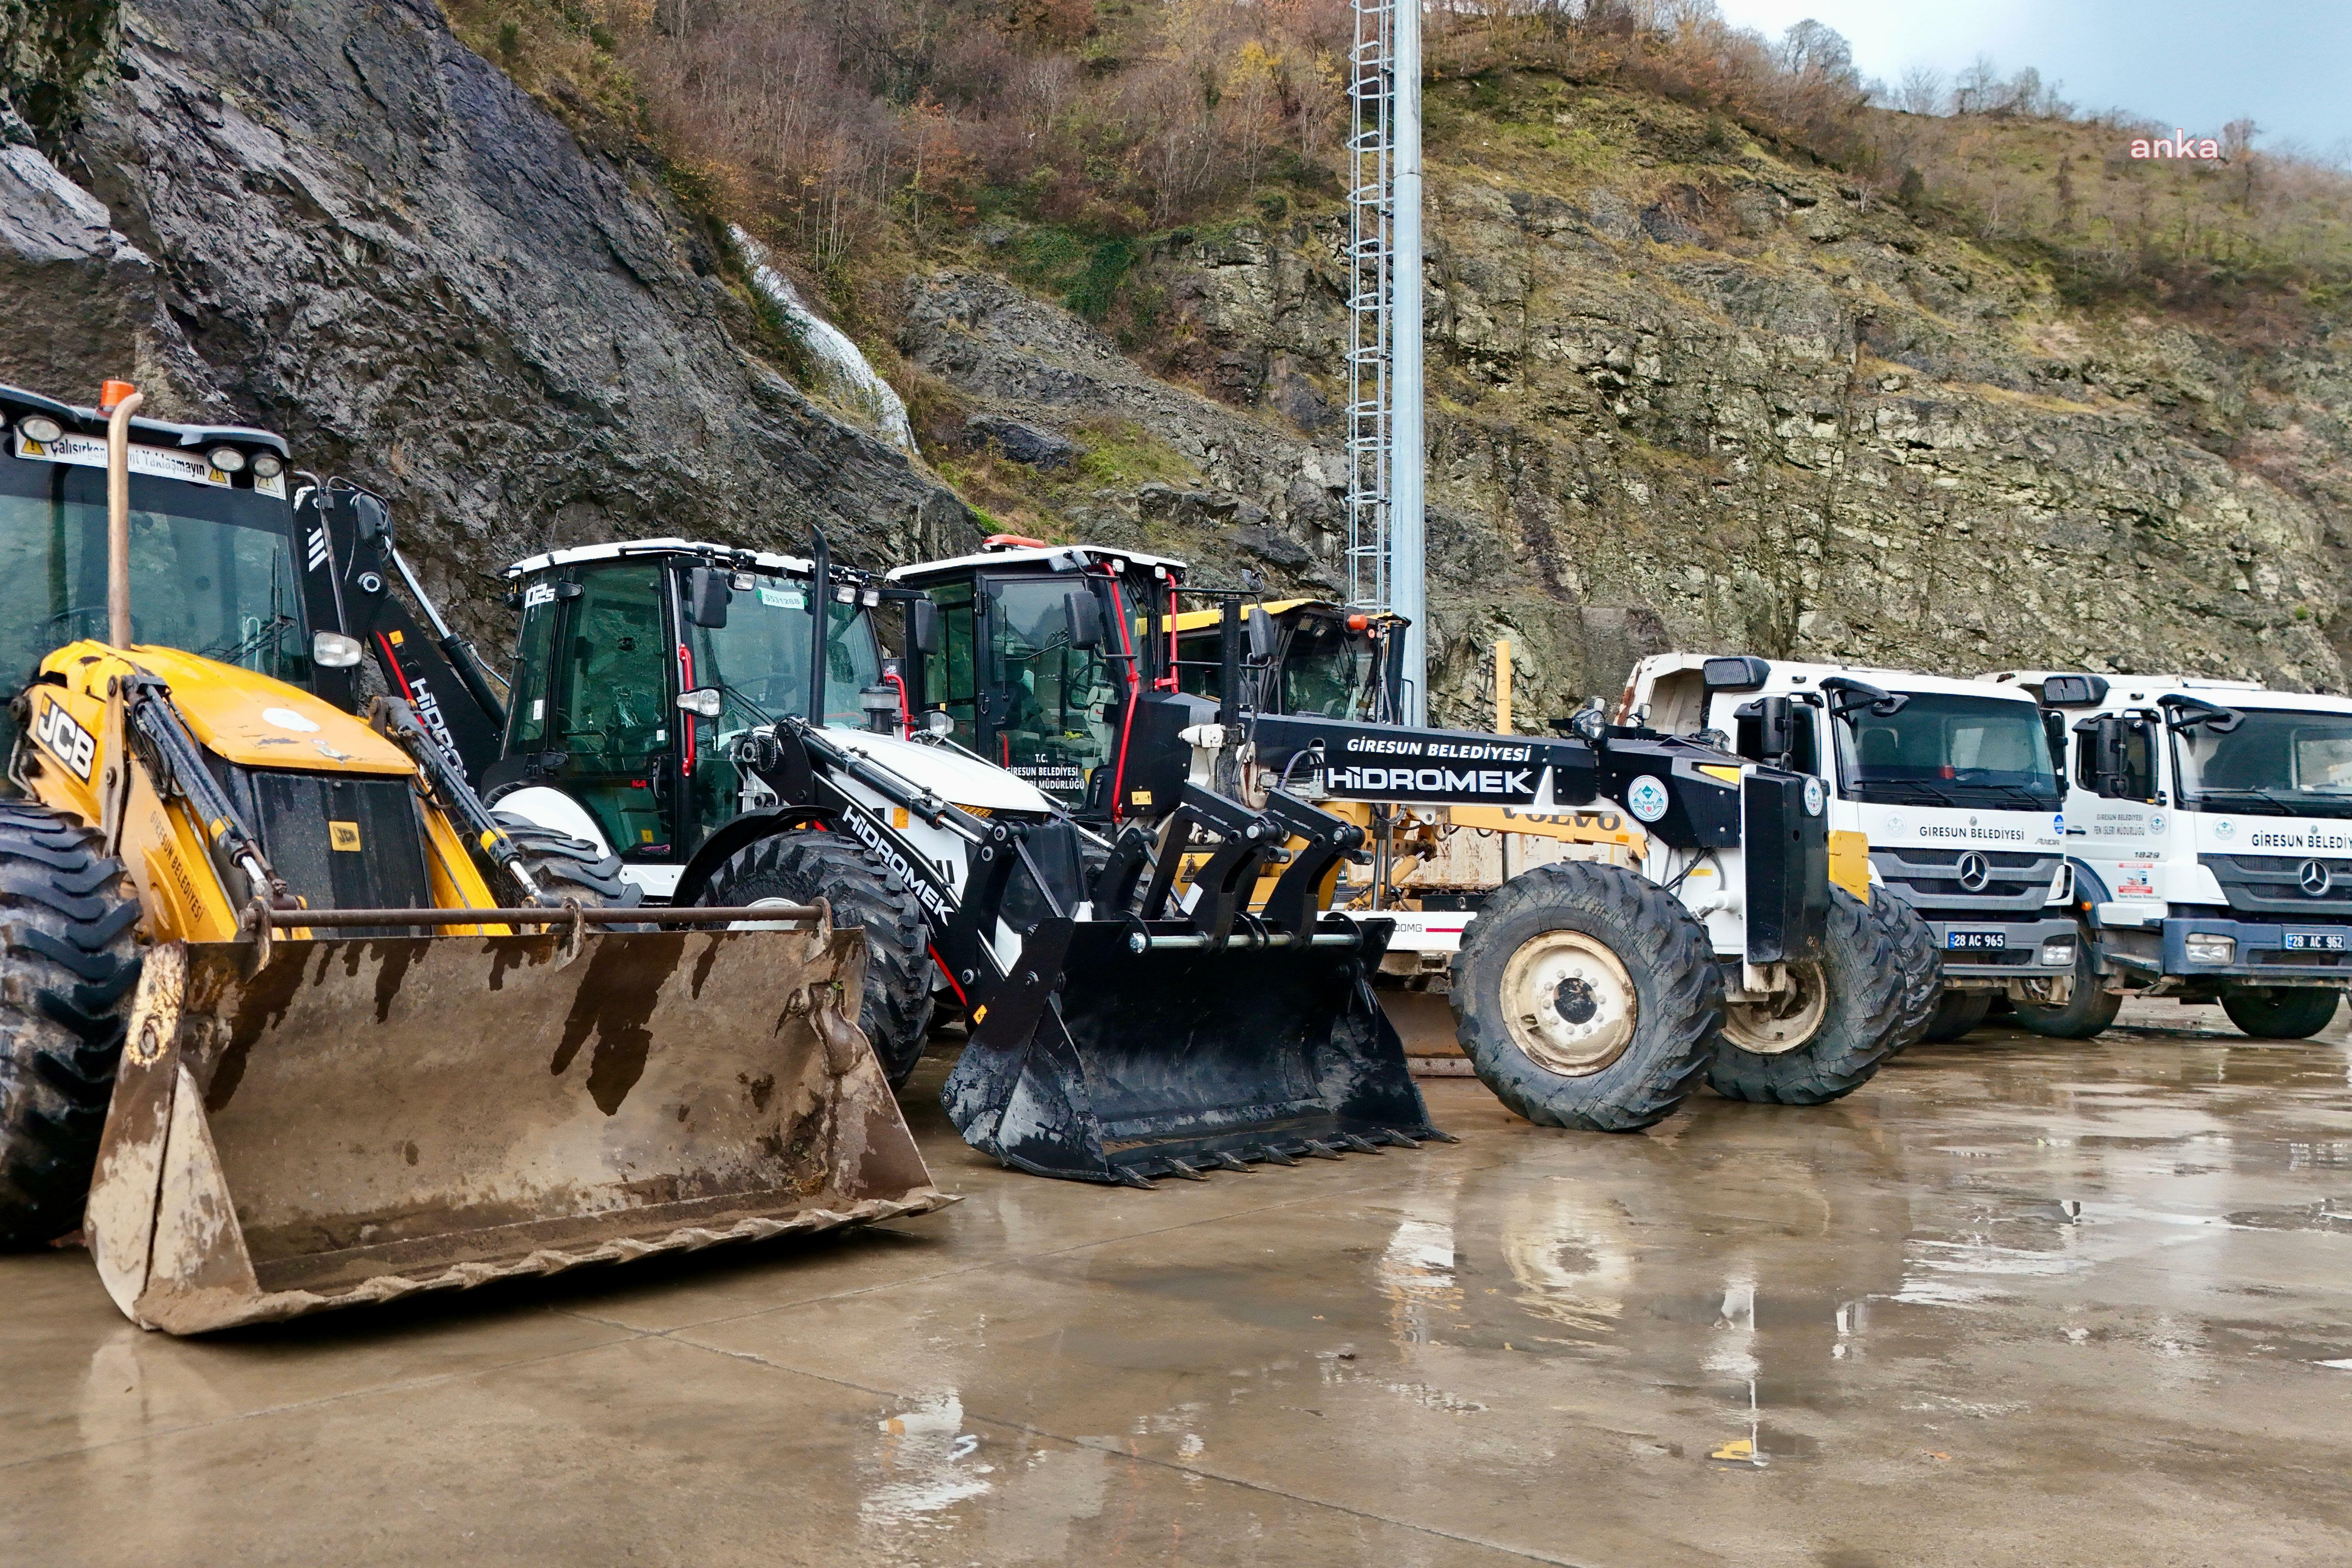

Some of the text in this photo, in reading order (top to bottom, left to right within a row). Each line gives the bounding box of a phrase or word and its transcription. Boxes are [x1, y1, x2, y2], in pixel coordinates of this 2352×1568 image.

[38, 704, 95, 779] JCB
[1347, 736, 1532, 761] GİRESUN BELEDİYESİ
[1035, 754, 1048, 763] T.C.
[1038, 764, 1079, 776] BELEDİYESİ
[632, 779, 646, 788] K4
[1038, 778, 1085, 790] MÜDÜRLÜĞÜ
[337, 828, 355, 843] JCB
[1920, 823, 2024, 840] GİRESUN BELEDİYESİ
[2252, 830, 2303, 847] GİRESUN
[171, 856, 205, 923] BELEDİYESİ
[1954, 934, 1966, 947] 28
[1968, 934, 1981, 947] AC
[1984, 935, 2004, 947] 965
[2292, 936, 2304, 947] 28
[2309, 936, 2321, 948] AC
[2326, 936, 2343, 948] 962
